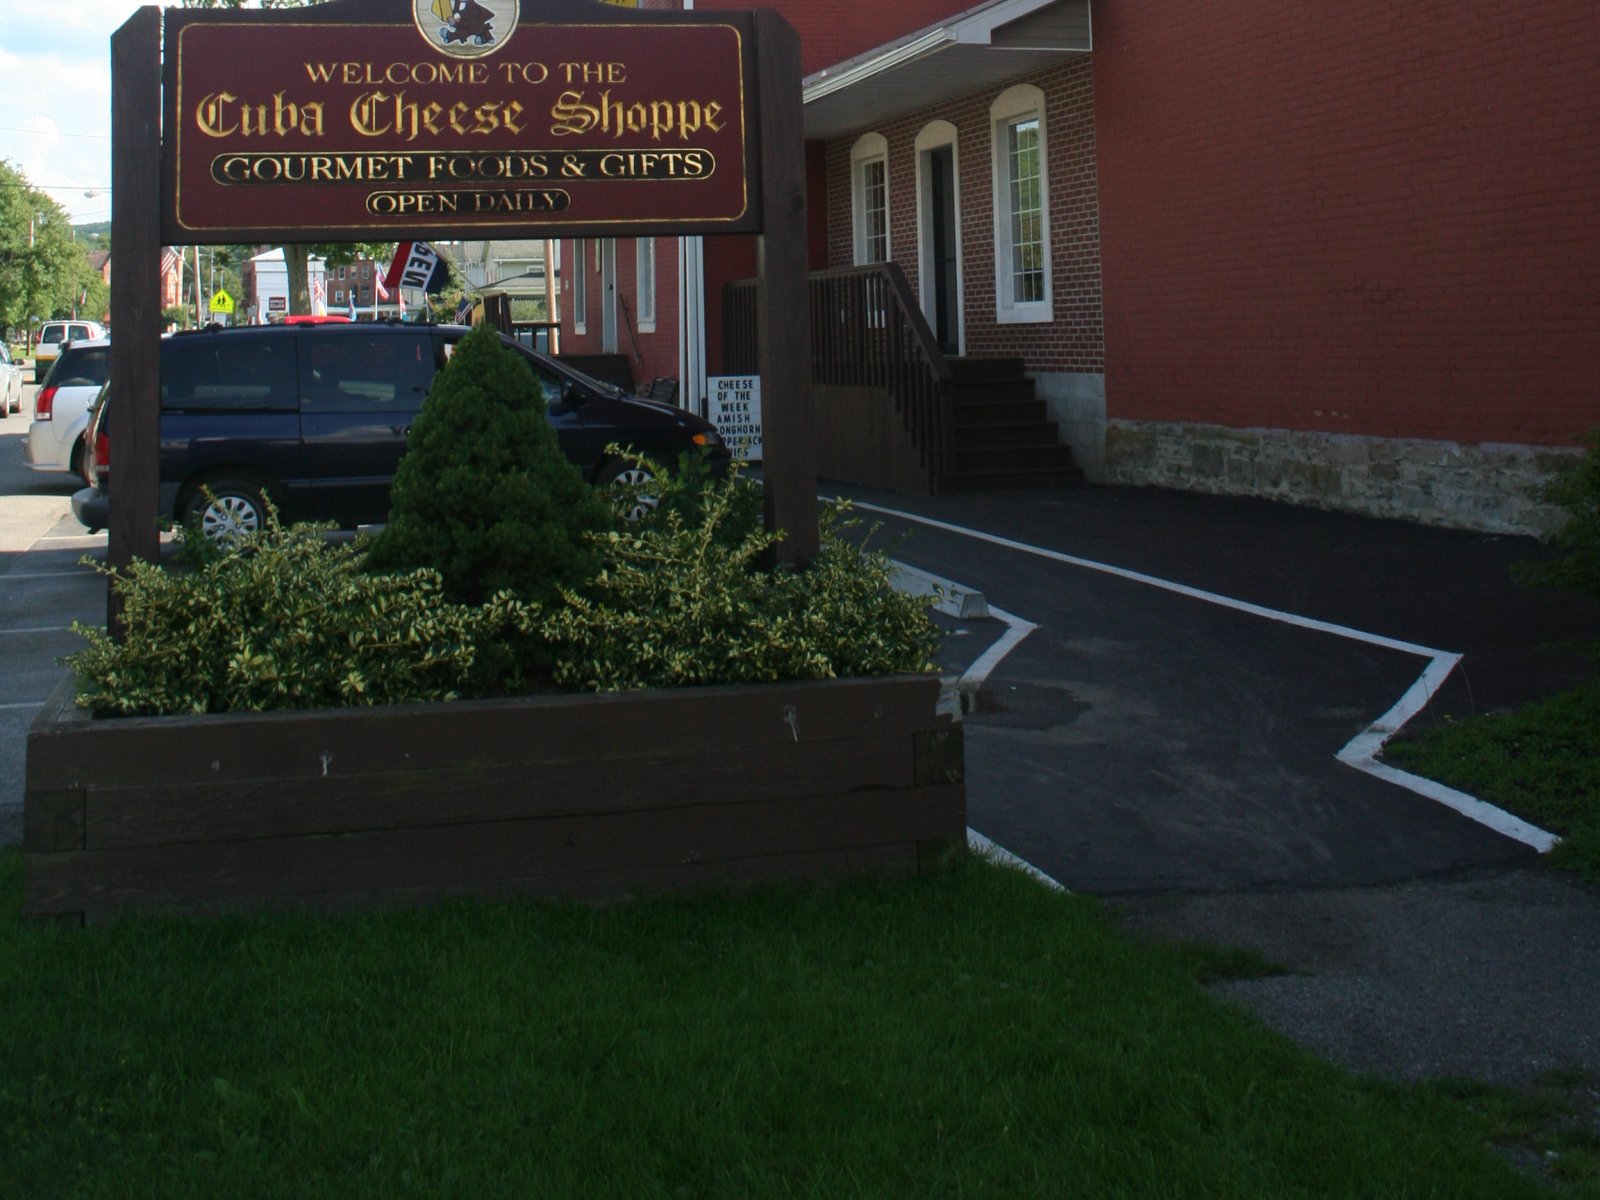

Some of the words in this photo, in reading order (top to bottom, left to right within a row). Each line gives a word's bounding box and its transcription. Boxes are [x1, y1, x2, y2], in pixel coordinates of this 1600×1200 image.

[304, 62, 490, 84] WELCOME
[498, 62, 548, 84] TO
[558, 62, 627, 84] THE
[195, 89, 325, 137] Cuba
[350, 90, 527, 142] Cheese
[550, 88, 726, 141] Shoppe
[223, 156, 414, 181] GOURMET
[428, 154, 549, 178] FOODS
[560, 154, 587, 177] &
[600, 153, 703, 177] GIFTS
[372, 194, 457, 213] OPEN
[474, 193, 561, 212] DAILY
[718, 380, 753, 390] CHEESE
[717, 391, 728, 401] OF
[734, 391, 751, 400] THE
[721, 403, 749, 412] WEEK
[717, 414, 750, 424] AMISH
[719, 424, 761, 435] ONGHORN
